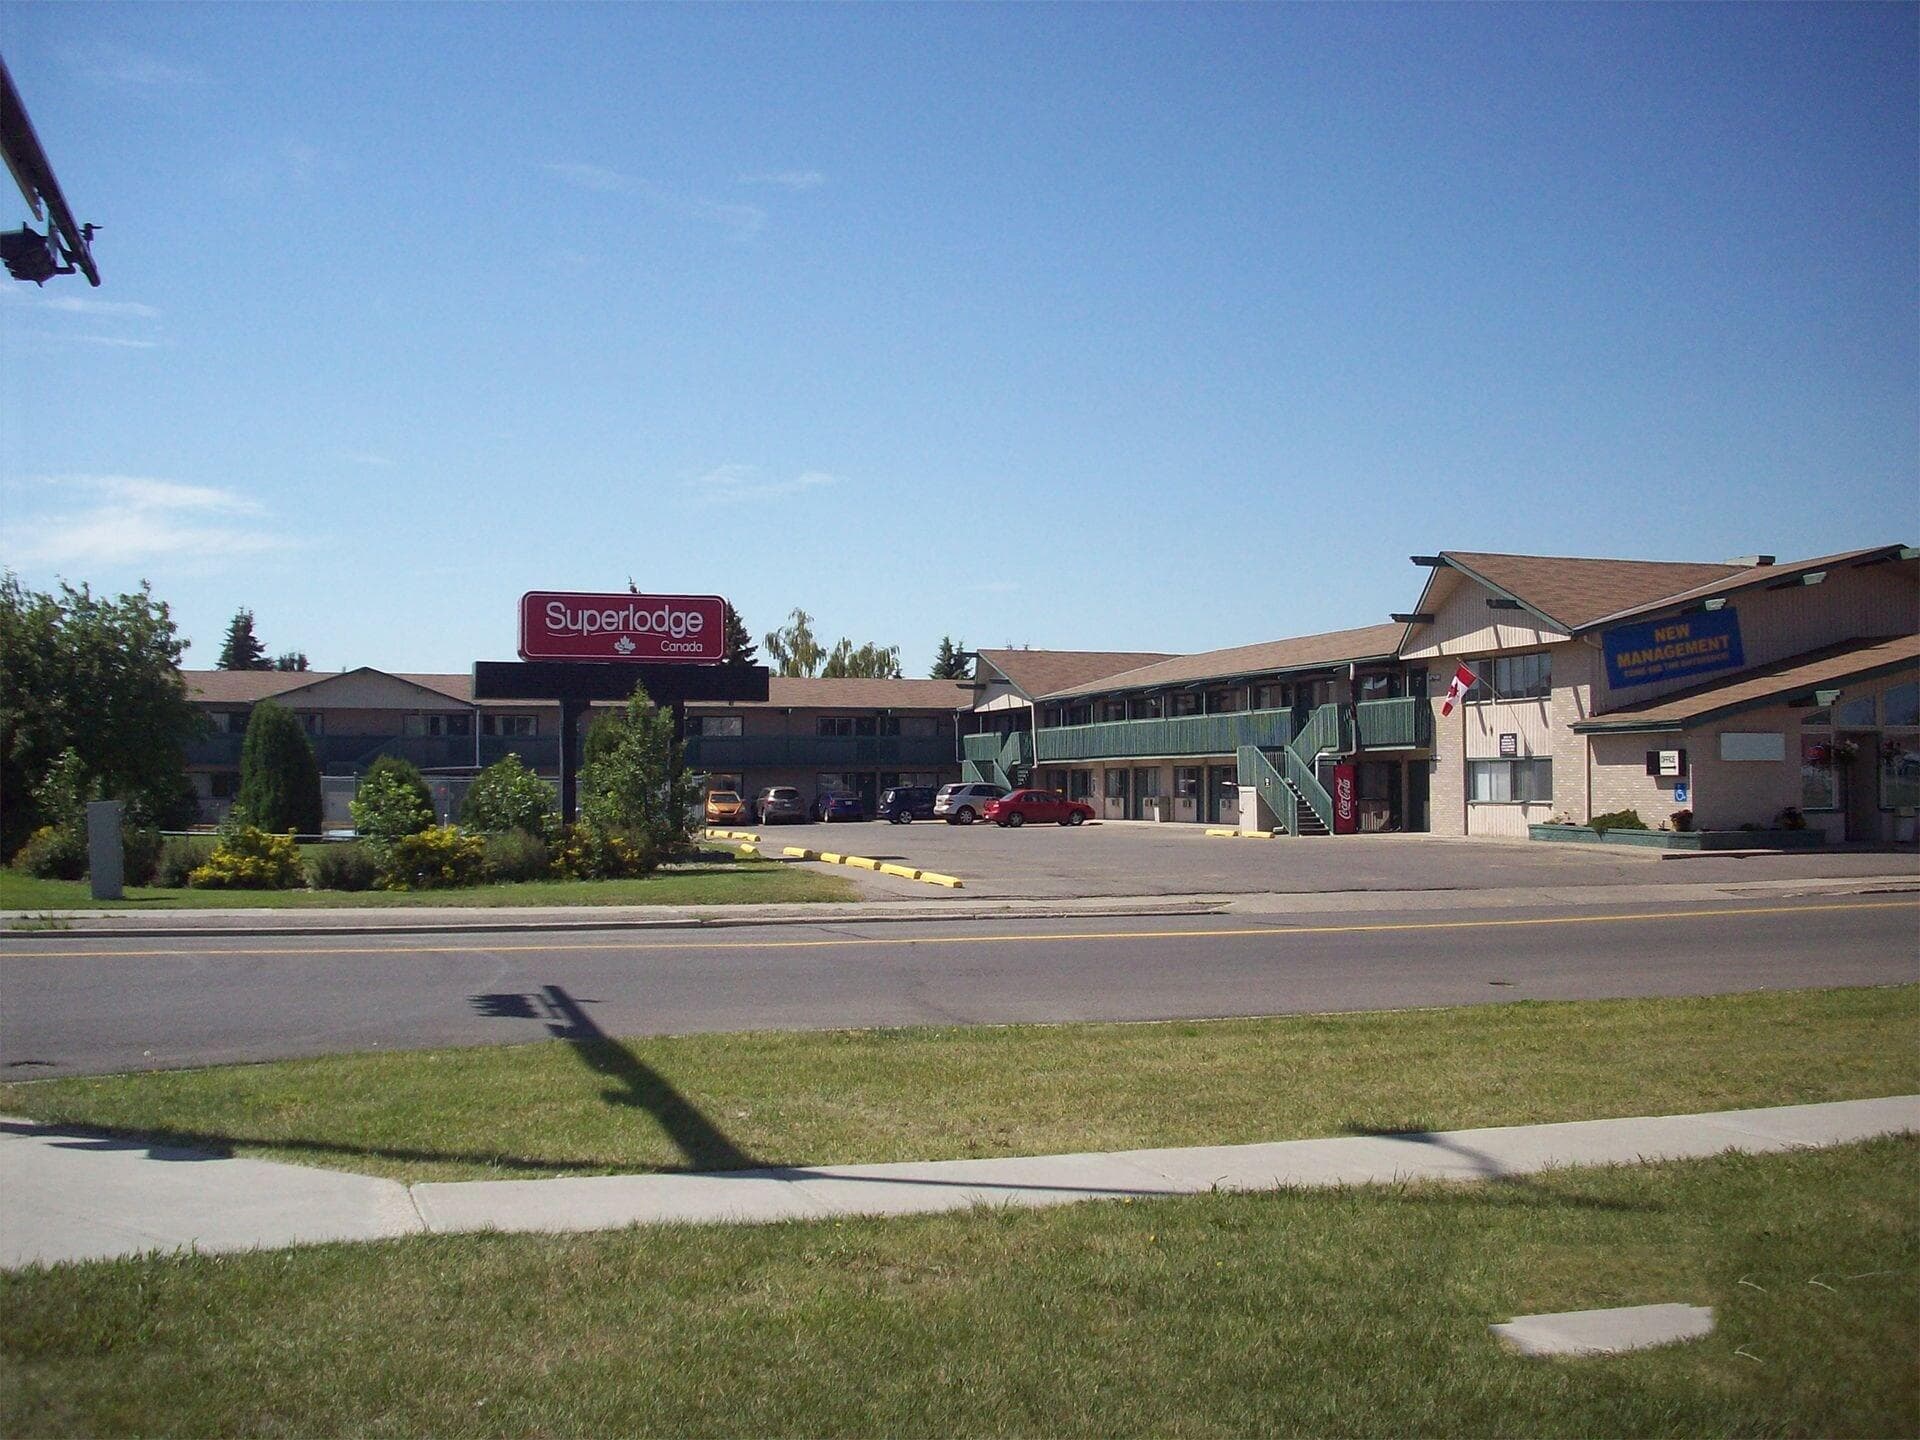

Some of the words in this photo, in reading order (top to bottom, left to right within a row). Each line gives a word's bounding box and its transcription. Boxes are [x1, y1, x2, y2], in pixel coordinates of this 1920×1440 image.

[545, 601, 703, 639] Superlodge
[1655, 623, 1690, 643] NEW
[660, 640, 703, 653] Canada
[1616, 635, 1729, 668] MANAGEMENT
